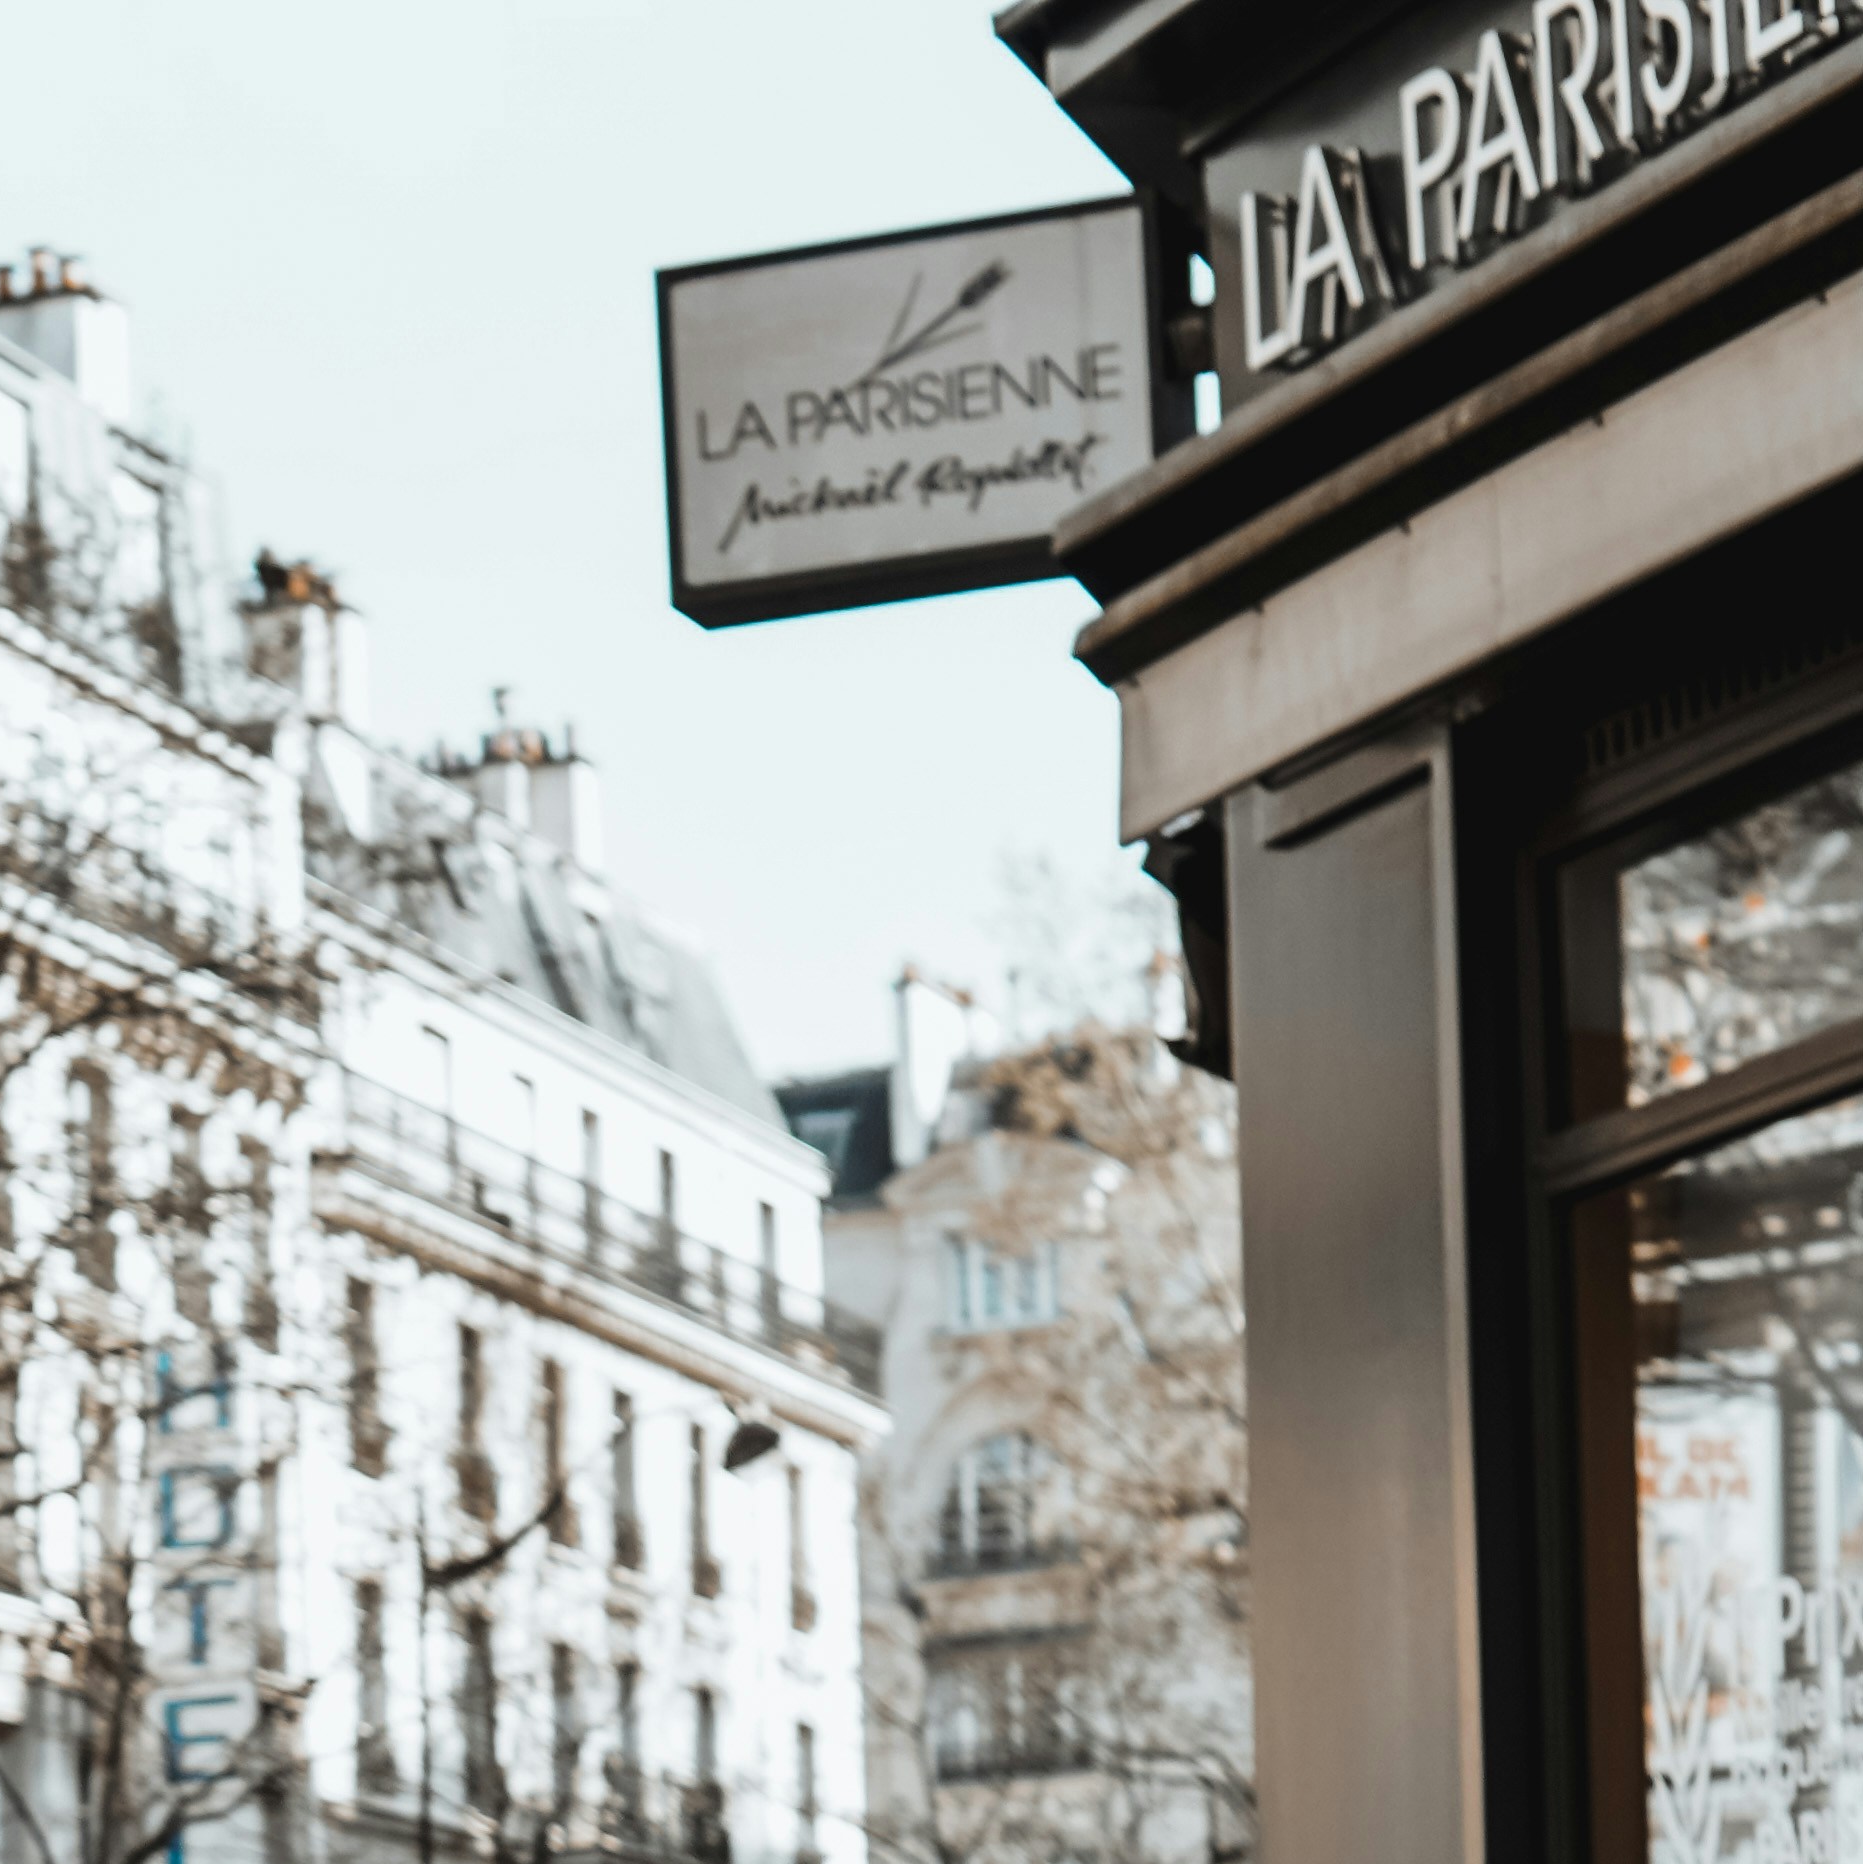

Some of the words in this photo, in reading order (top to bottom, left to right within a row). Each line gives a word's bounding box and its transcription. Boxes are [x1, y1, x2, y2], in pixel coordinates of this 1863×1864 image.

[1240, 143, 1365, 371] LA
[695, 401, 778, 462] LA
[784, 342, 1124, 446] PARISIENNE
